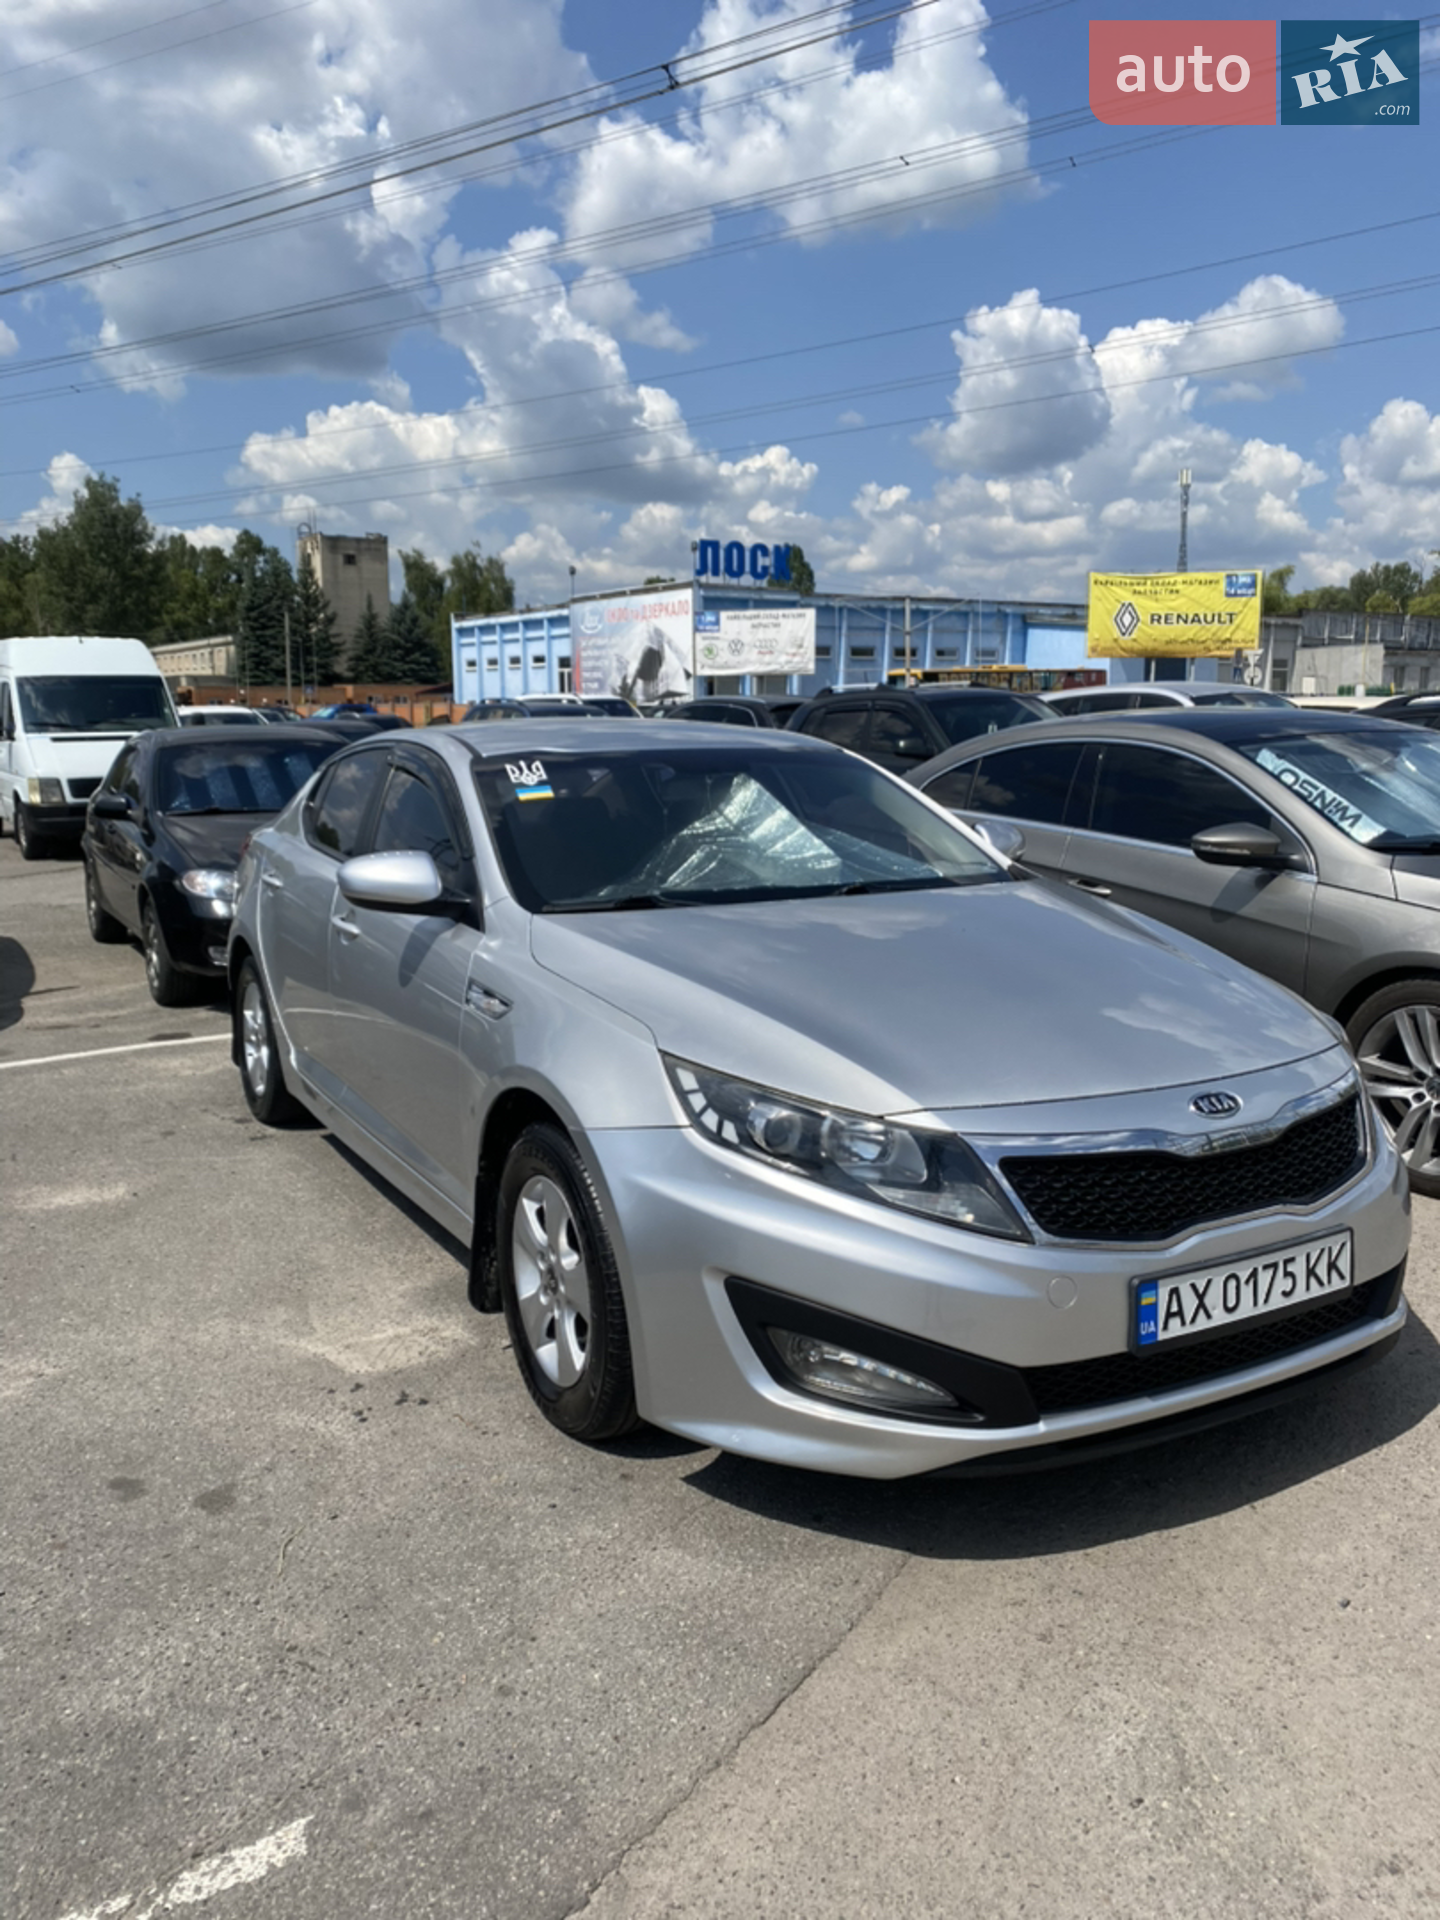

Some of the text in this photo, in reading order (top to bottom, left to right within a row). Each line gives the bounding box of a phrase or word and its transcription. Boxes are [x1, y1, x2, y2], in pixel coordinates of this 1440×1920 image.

[695, 539, 792, 581] ЛОСК
[640, 598, 690, 622] ДЗЕРКАЛО
[1149, 612, 1237, 626] RENAULT
[1196, 1094, 1236, 1113] KIA
[1161, 1241, 1349, 1332] AX 0175 KK
[1140, 1319, 1157, 1335] UA
